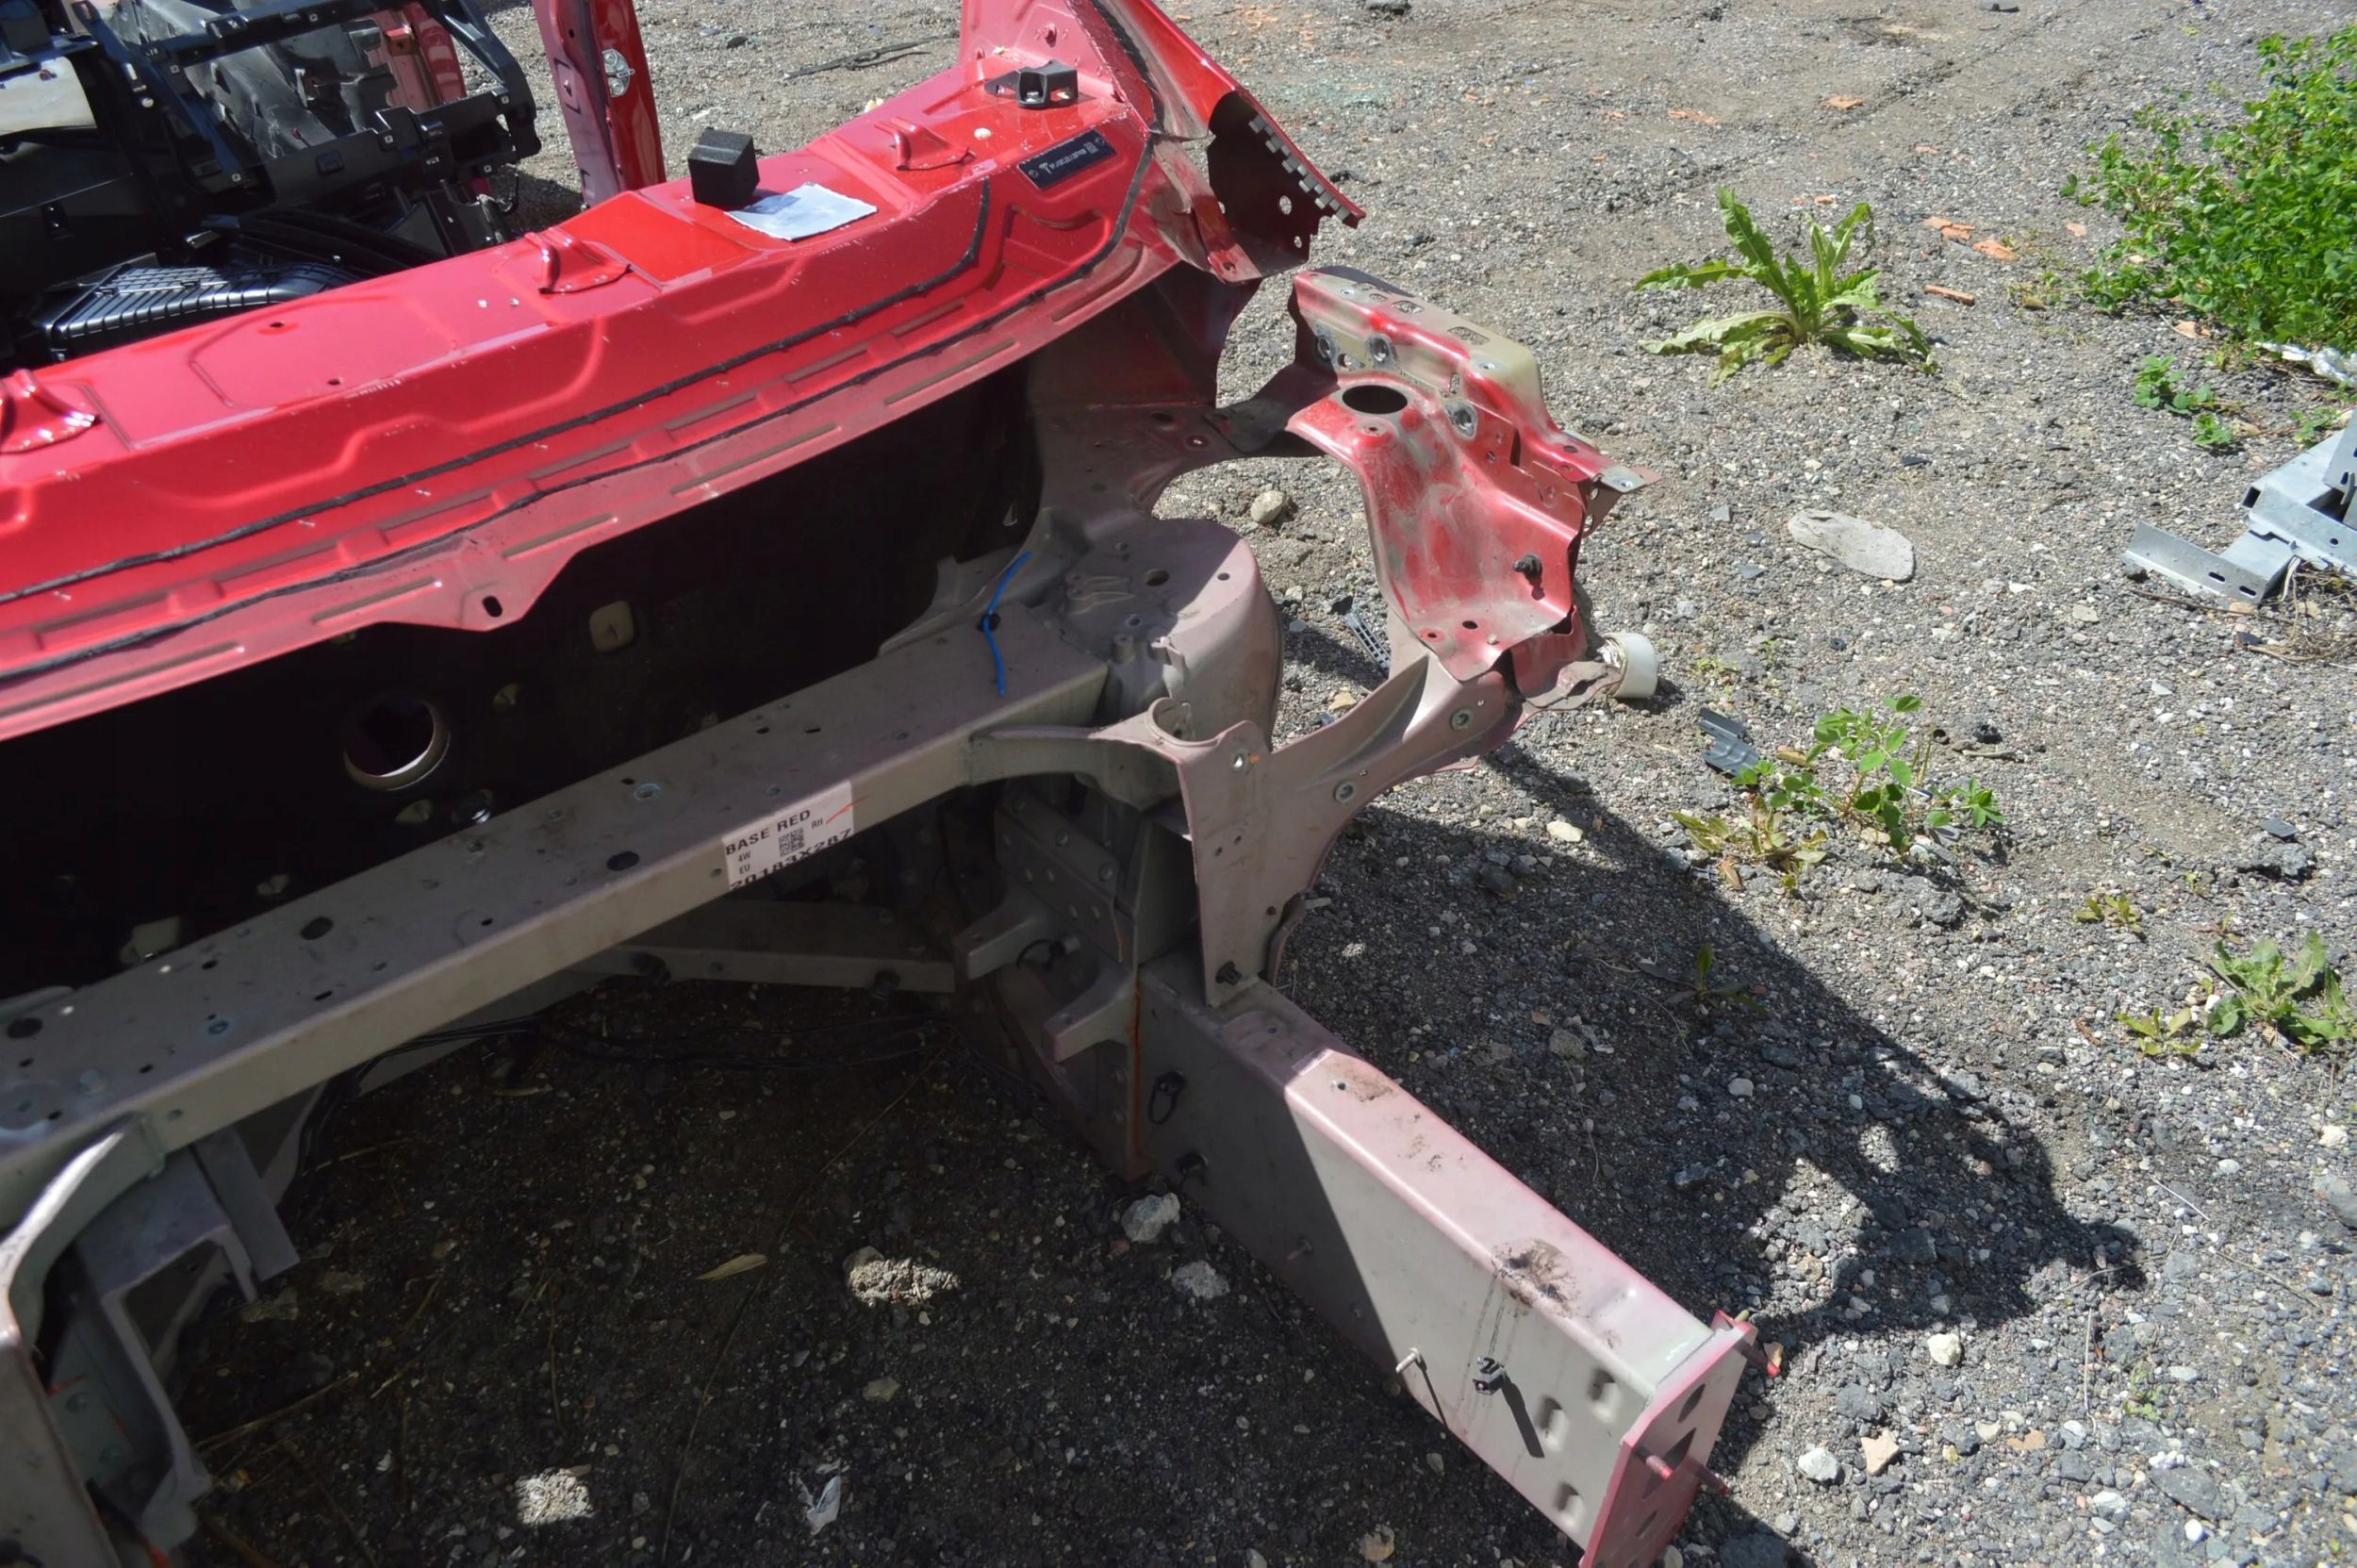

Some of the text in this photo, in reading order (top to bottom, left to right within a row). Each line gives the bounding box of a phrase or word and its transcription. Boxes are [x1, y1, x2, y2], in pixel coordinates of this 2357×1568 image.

[811, 817, 823, 830] RH
[725, 809, 811, 855] BASE RED
[737, 850, 751, 863] 4W
[739, 865, 750, 875] EU
